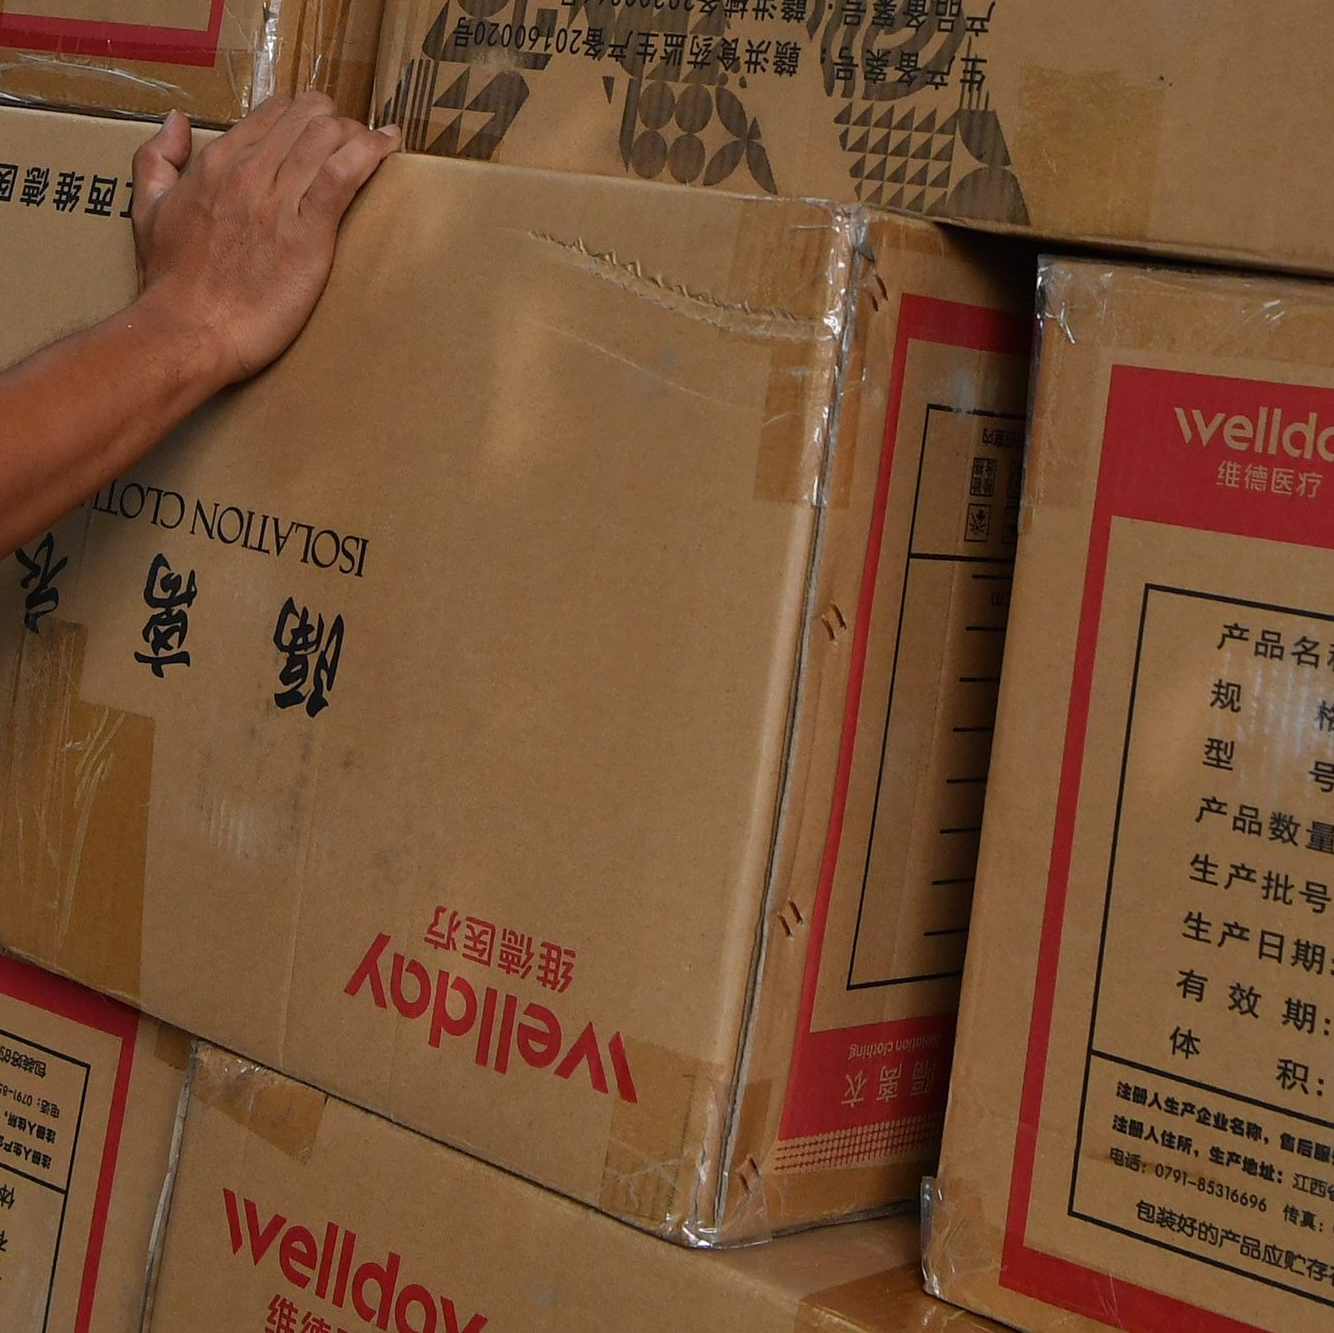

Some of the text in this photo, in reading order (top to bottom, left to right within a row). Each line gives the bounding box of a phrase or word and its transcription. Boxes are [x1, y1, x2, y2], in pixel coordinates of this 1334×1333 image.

[1215, 460, 1324, 499] 维德医疗
[189, 498, 369, 578] ISOLATION
[424, 905, 577, 994] 维德医疗
[344, 932, 638, 1104] wellday
[1176, 969, 1333, 1039] 有效期：
